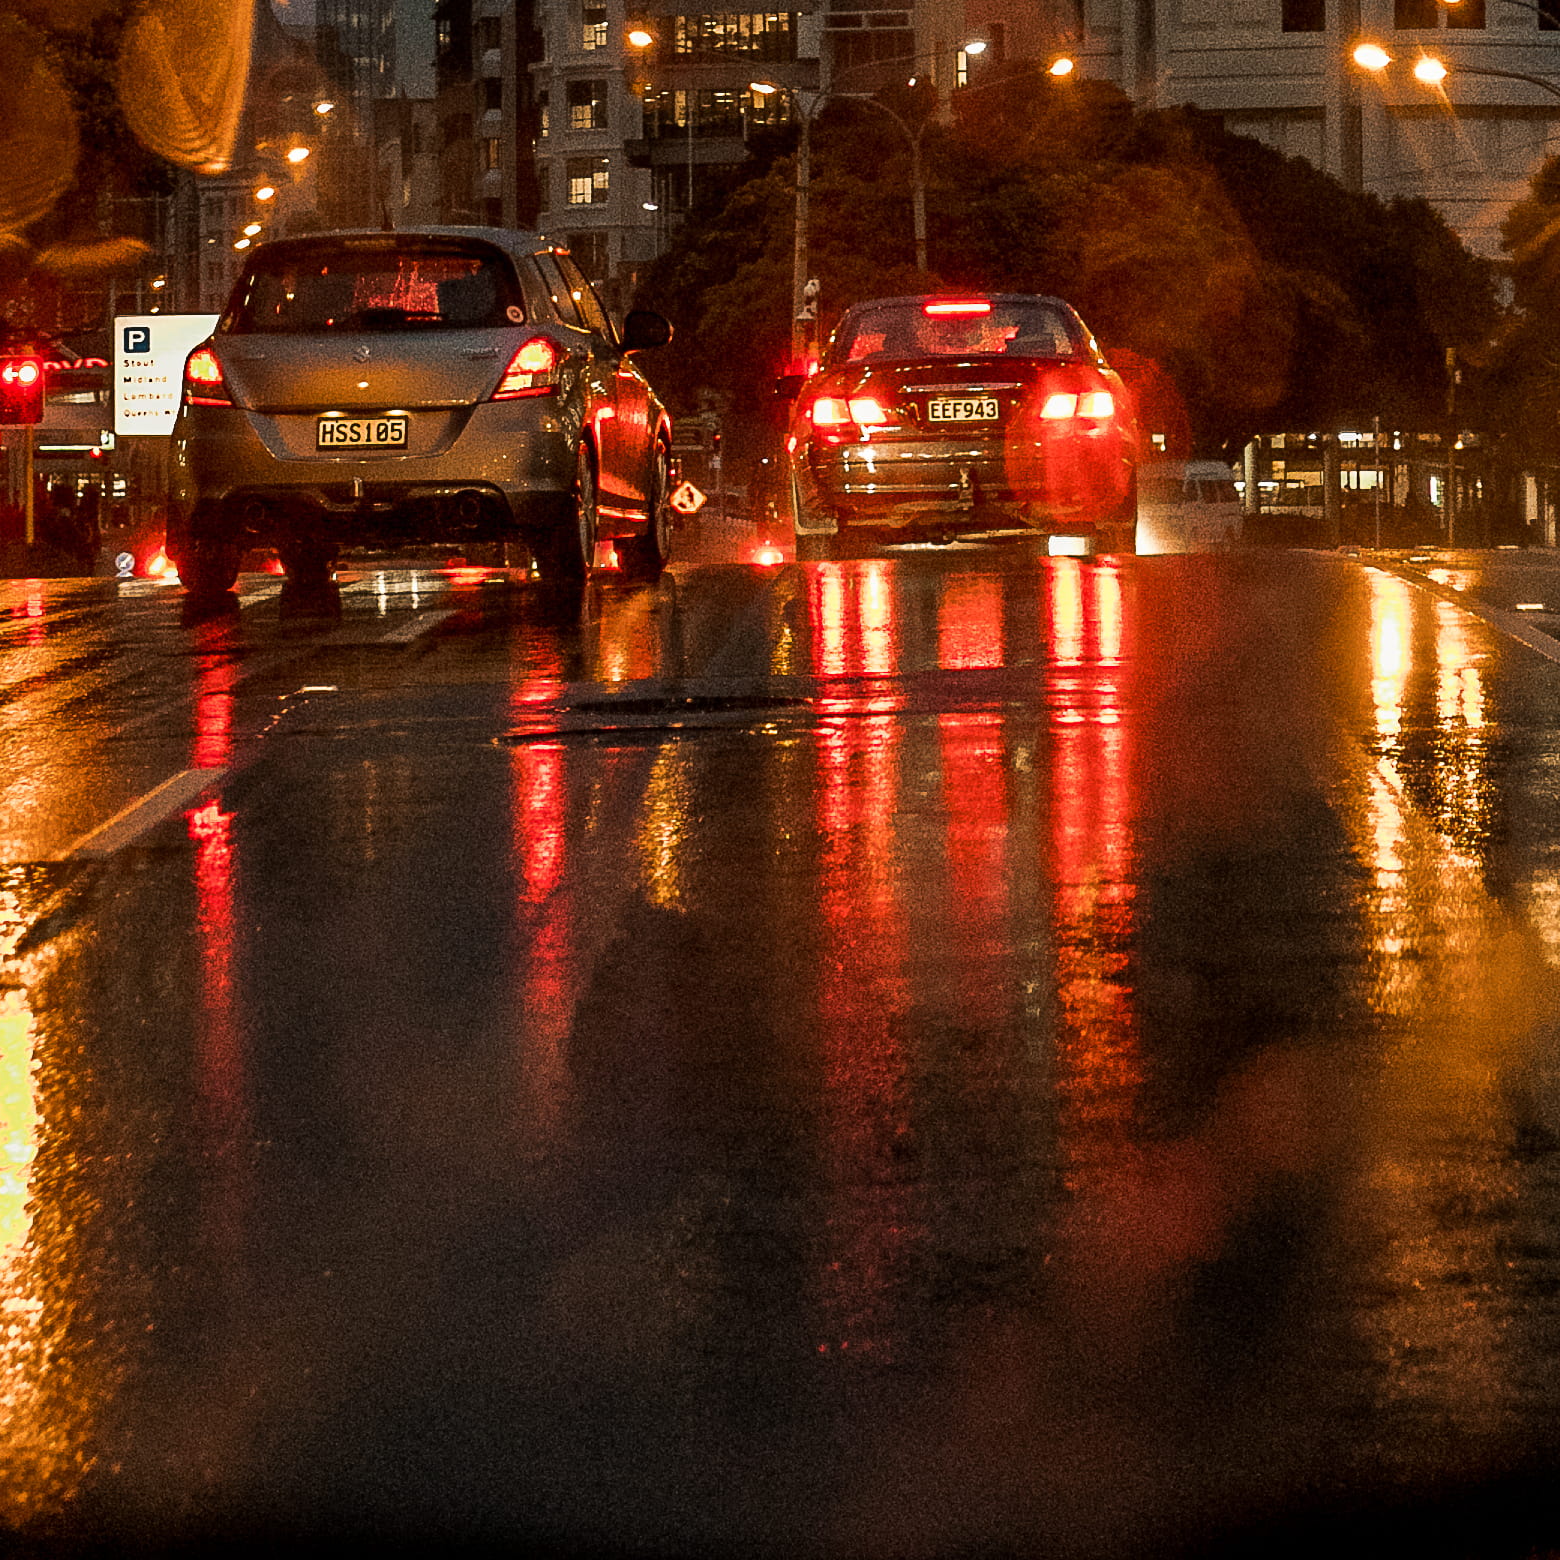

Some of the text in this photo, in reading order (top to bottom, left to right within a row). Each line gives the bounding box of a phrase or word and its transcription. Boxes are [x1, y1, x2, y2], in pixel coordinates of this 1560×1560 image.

[123, 360, 154, 368] Stout
[123, 376, 167, 384] Midland
[930, 402, 997, 419] EEF943
[321, 422, 403, 443] HSS105
